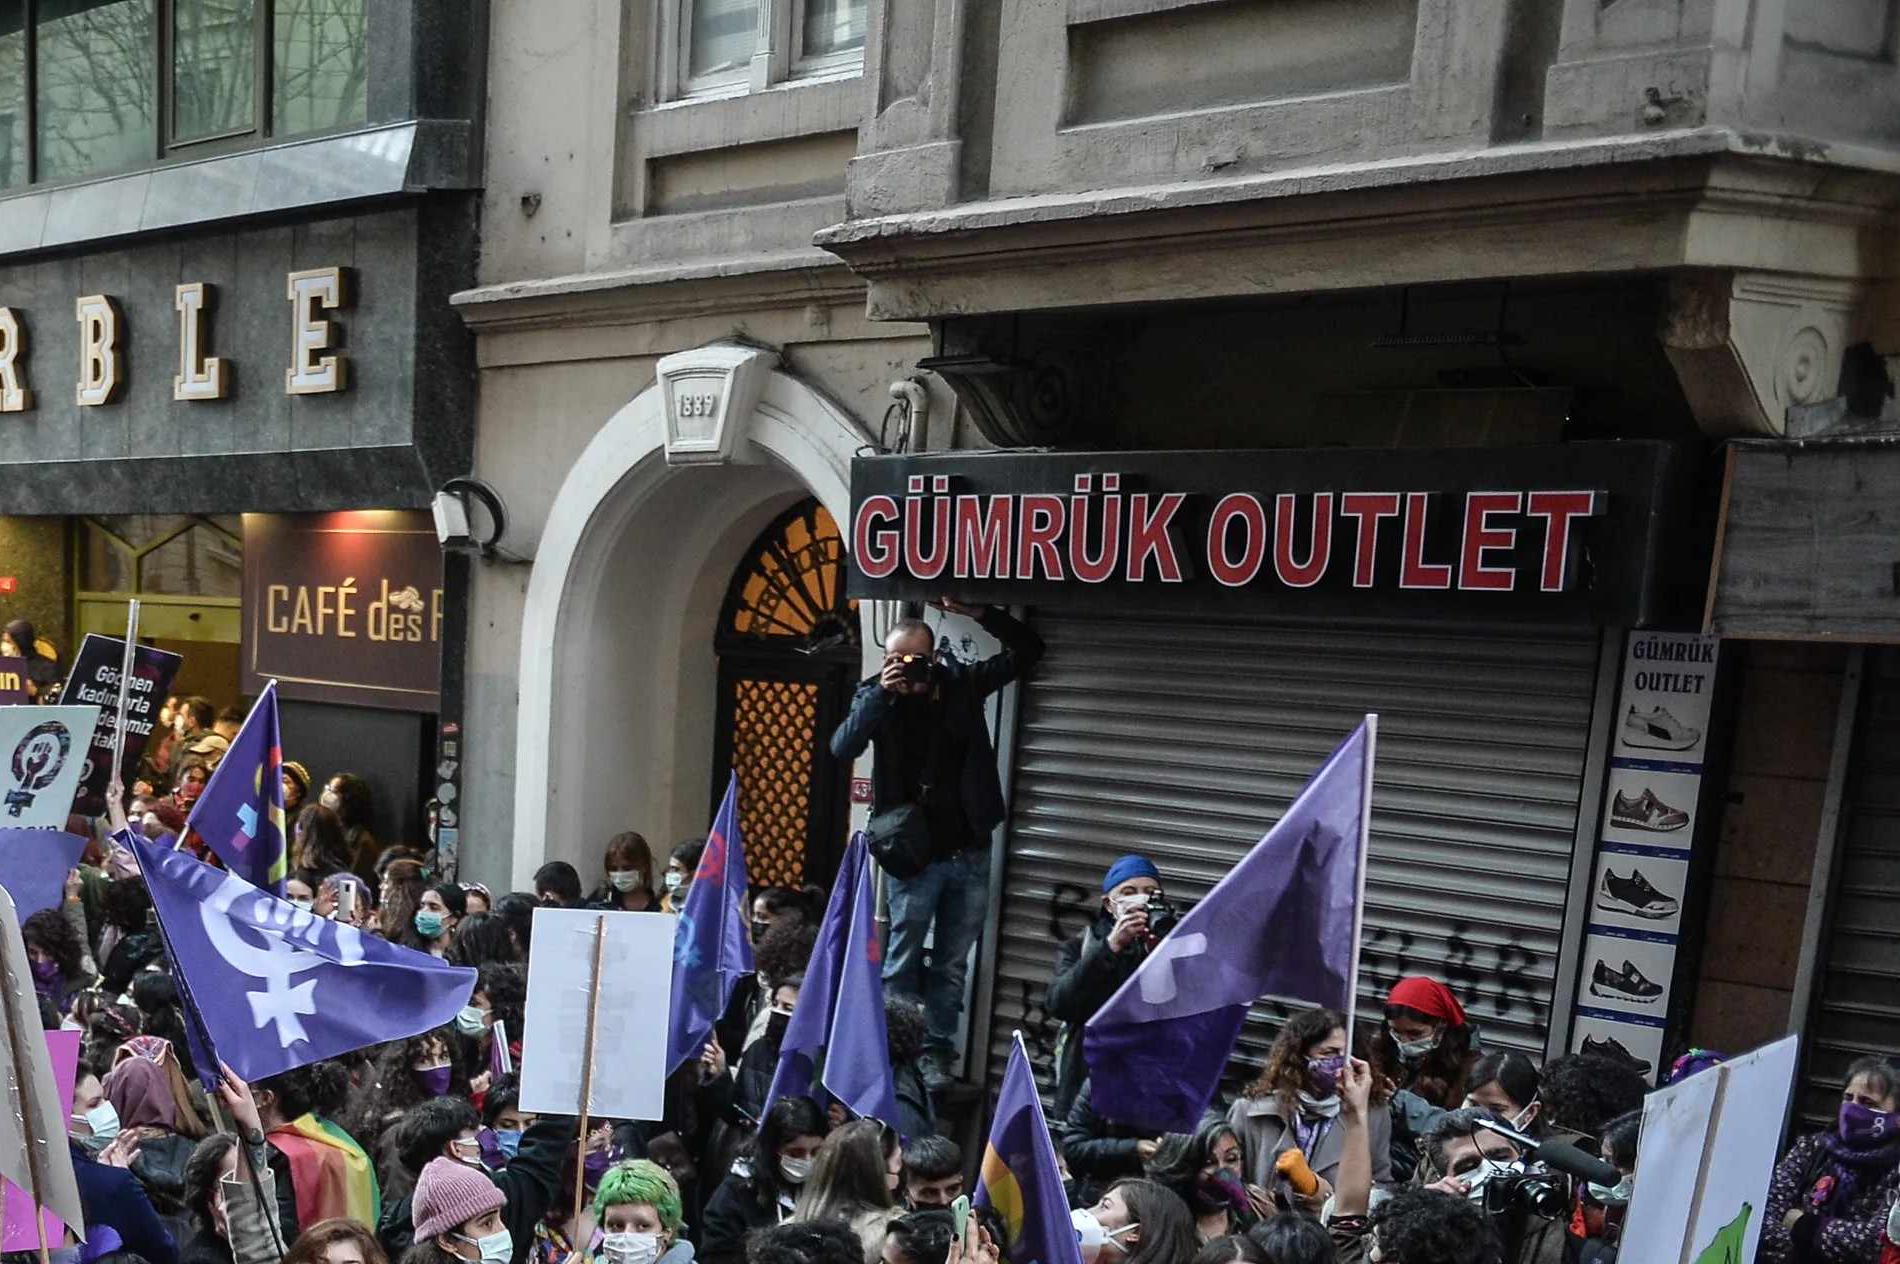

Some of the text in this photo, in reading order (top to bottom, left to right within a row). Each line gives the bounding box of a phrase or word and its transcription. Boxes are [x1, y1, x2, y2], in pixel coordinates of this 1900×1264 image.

[677, 392, 715, 417] 1889
[852, 473, 1595, 593] GÜMRÜK OUTLET
[267, 577, 358, 638] CAFÉ
[367, 578, 423, 642] des
[1632, 635, 1715, 664] GÜMRÜK
[1634, 671, 1706, 694] OUTLET
